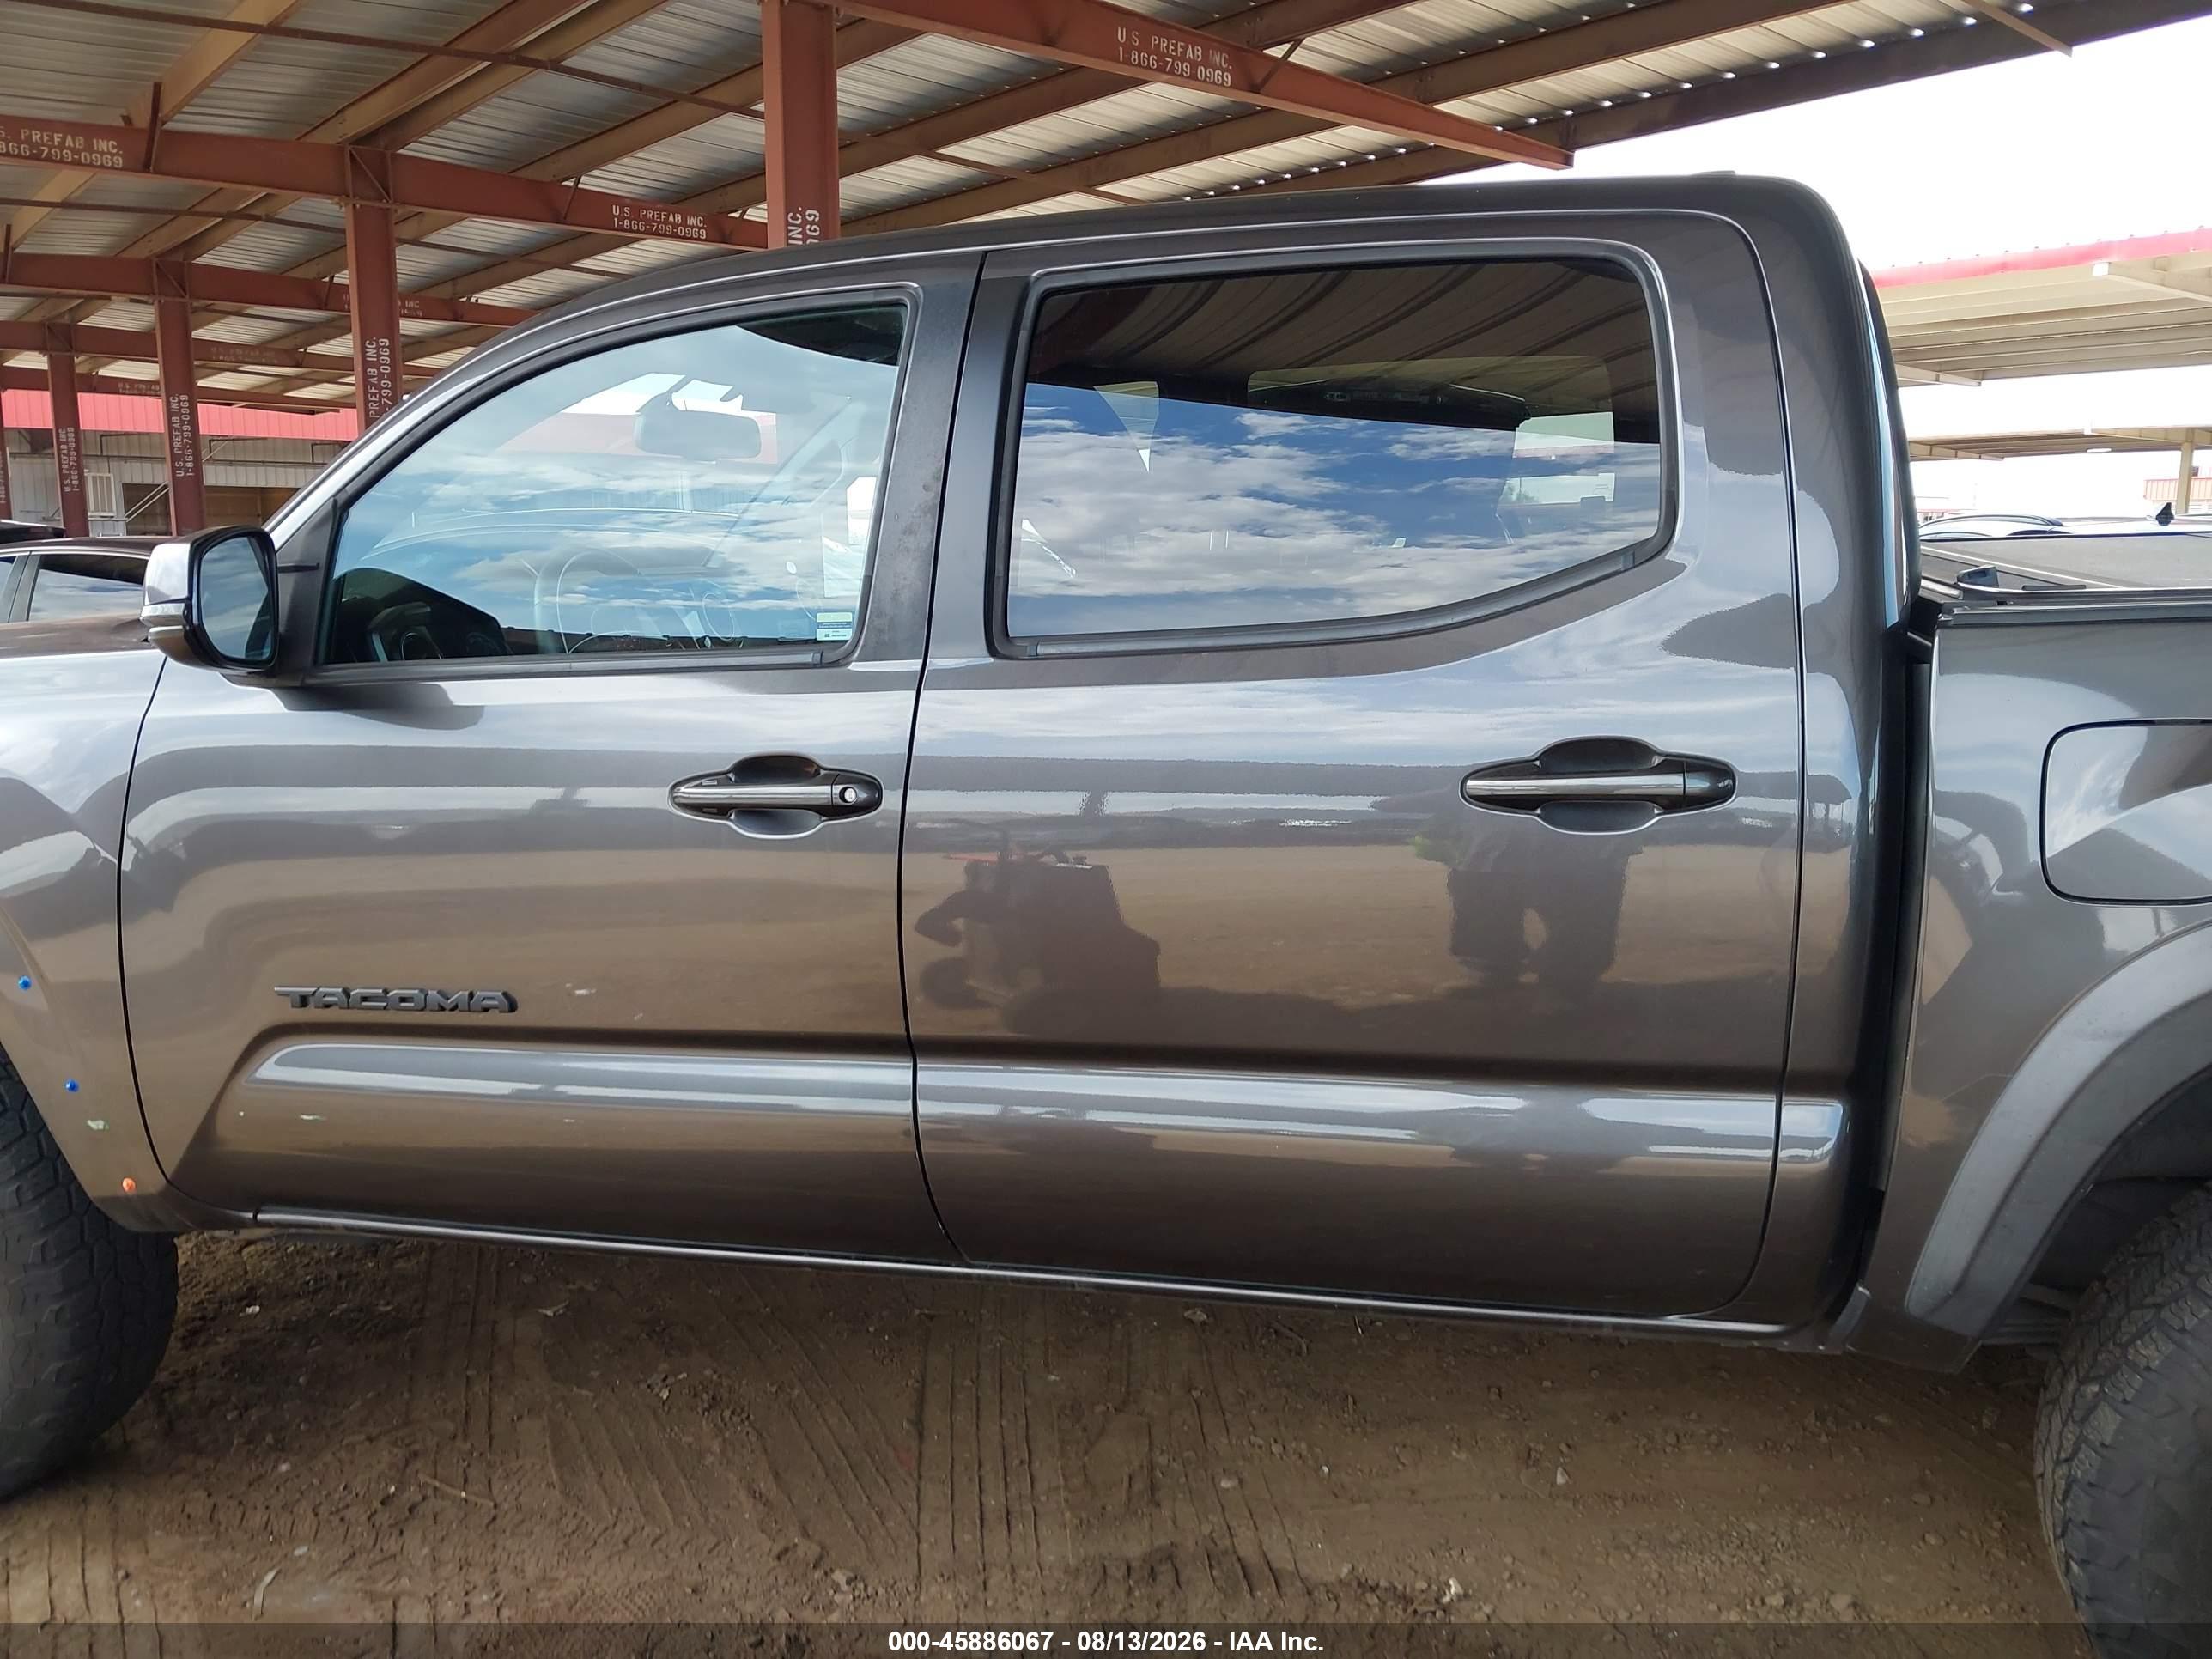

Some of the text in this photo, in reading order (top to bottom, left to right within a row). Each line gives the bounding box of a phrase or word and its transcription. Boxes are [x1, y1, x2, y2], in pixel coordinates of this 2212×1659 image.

[1151, 35, 1202, 62] PREFAB
[1209, 48, 1232, 70] INC.
[20, 128, 84, 149] PREFAB
[93, 138, 123, 154] INC.
[614, 217, 707, 240] 1-866-799-0969
[640, 209, 682, 224] PREFAB
[687, 215, 707, 228] INC.
[787, 206, 804, 245] INC.
[365, 337, 380, 418] PREFAB INC.
[378, 338, 392, 411] -799-0969
[169, 393, 179, 412] INC.
[171, 416, 183, 453] PREFAB
[179, 394, 194, 476] 1-866-799-0969
[274, 986, 518, 1013] TACOMA
